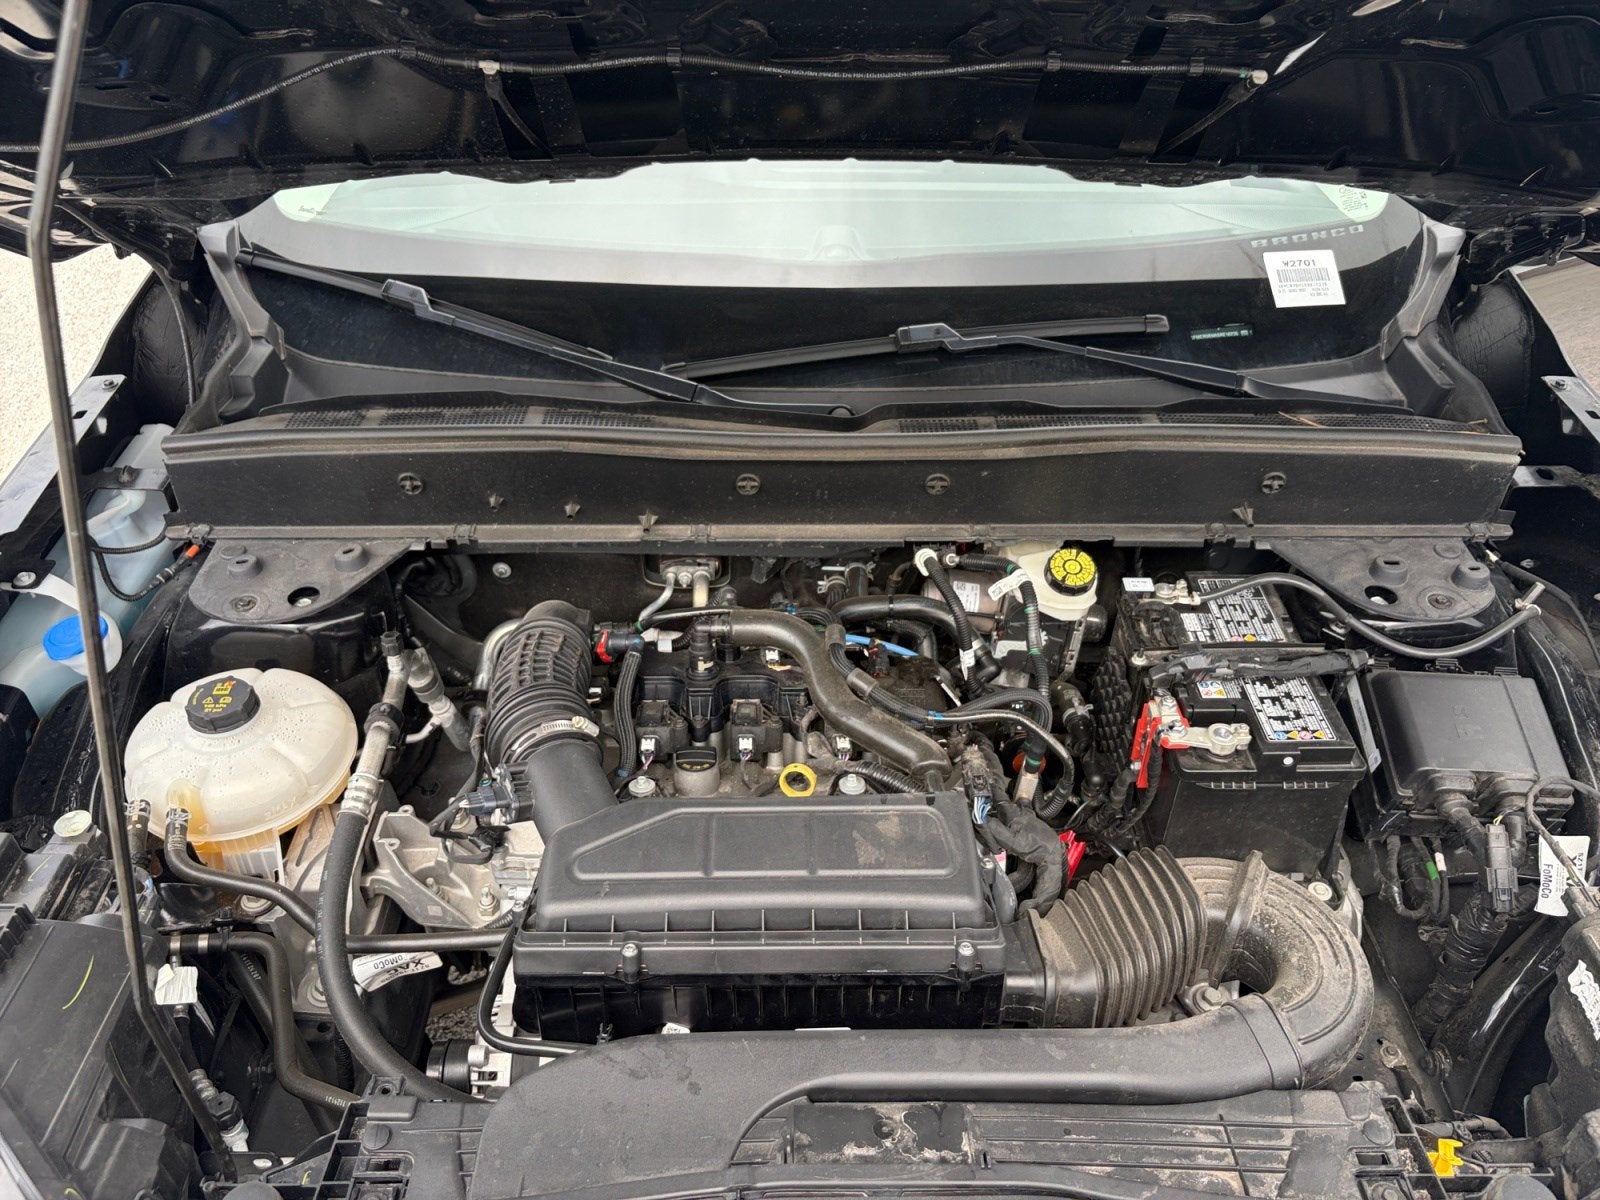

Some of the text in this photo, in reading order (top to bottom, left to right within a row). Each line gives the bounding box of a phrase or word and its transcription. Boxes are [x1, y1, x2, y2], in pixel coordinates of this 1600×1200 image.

[1250, 224, 1364, 248] BRONCO
[1282, 259, 1316, 267] W2701
[1541, 863, 1554, 899] FoMoCo
[373, 954, 409, 970] oMoCo
